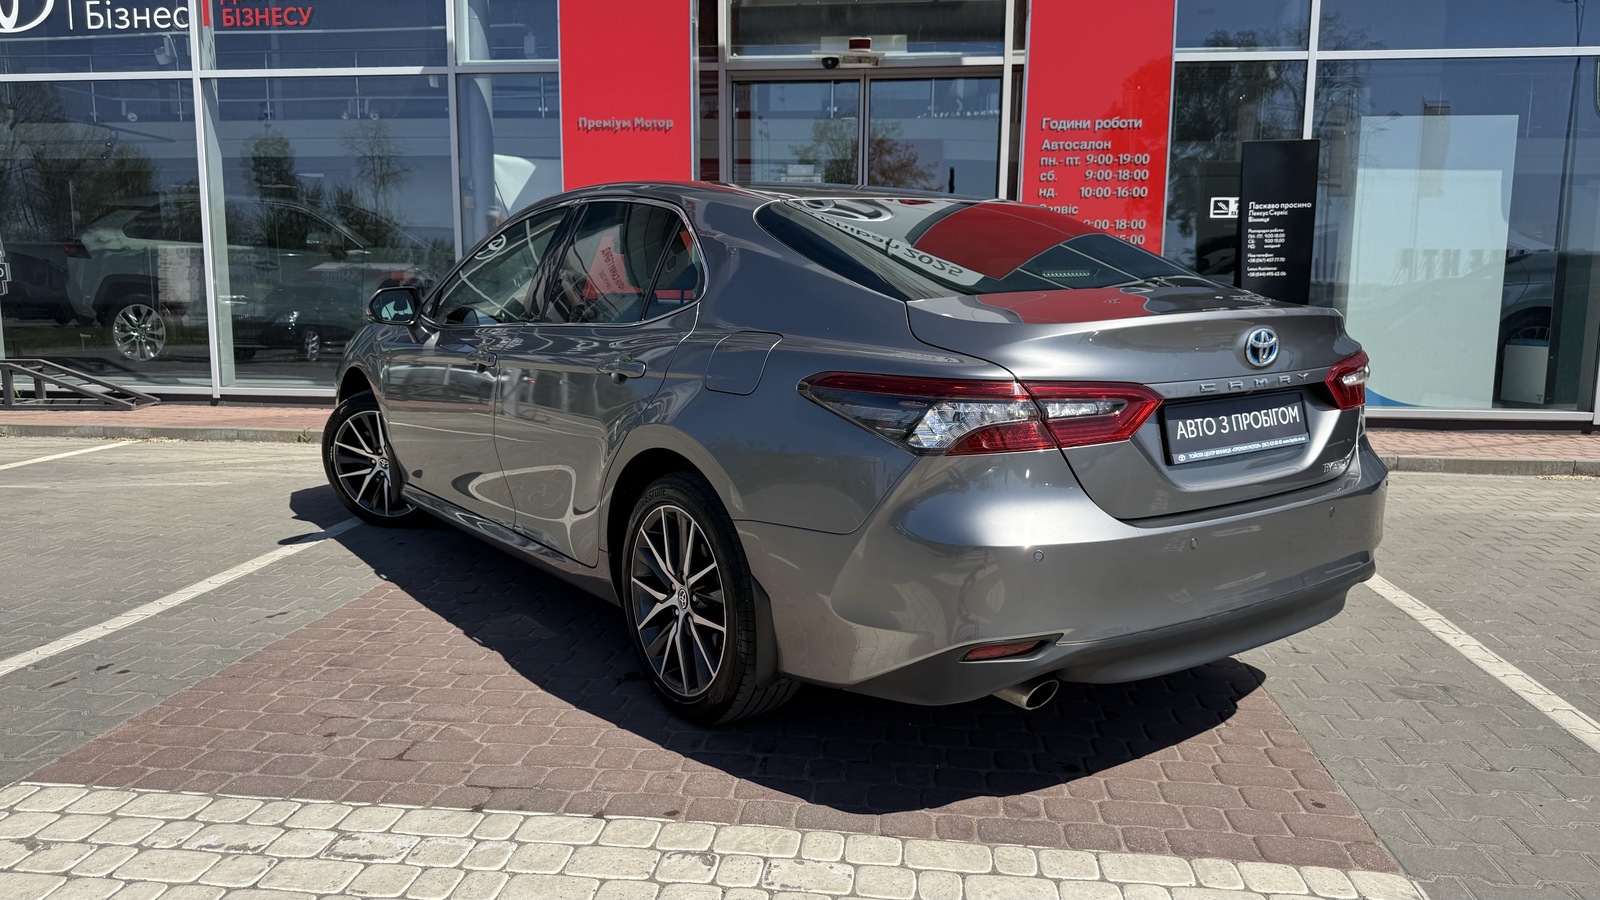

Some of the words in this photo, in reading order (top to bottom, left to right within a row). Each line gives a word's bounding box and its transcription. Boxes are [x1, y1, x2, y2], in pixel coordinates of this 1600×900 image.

[86, 1, 190, 29] Бізнес
[222, 7, 312, 27] БІЗНЕСУ
[578, 116, 631, 130] Преміум
[633, 117, 674, 130] Мотор
[1042, 118, 1091, 131] Години
[1094, 117, 1142, 131] роботи
[1041, 140, 1111, 150] Автосалон
[1086, 154, 1150, 165] 9:00-19:00
[1085, 170, 1149, 181] 9:00-18:00
[1080, 187, 1148, 198] 10:00-16:00
[1248, 201, 1279, 210] Ласкаво
[1280, 202, 1312, 210] просимо
[1200, 373, 1309, 392] CAMRY
[1177, 417, 1217, 440] АВТО
[1220, 416, 1229, 433] З
[1232, 406, 1300, 431] ПРОБІГОМ
